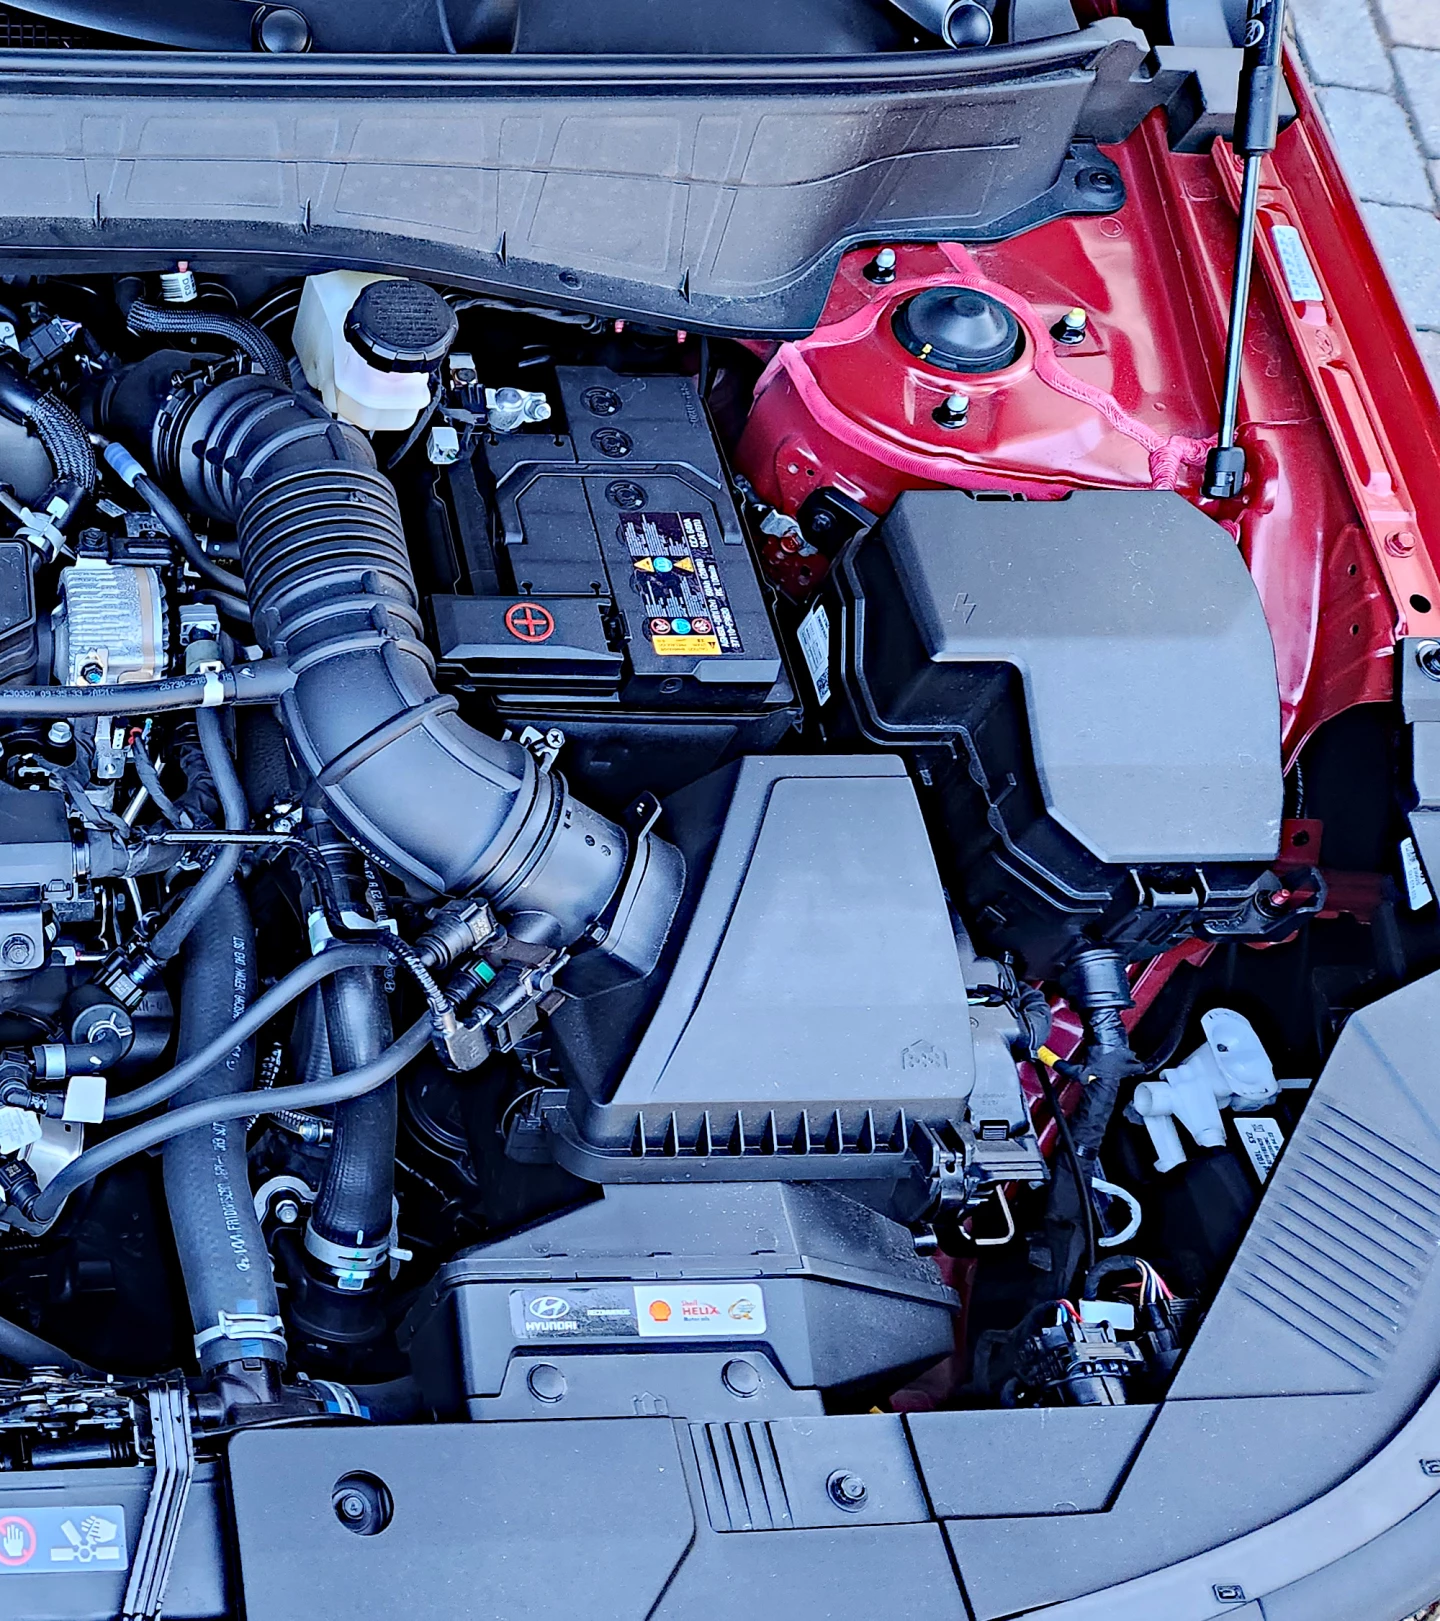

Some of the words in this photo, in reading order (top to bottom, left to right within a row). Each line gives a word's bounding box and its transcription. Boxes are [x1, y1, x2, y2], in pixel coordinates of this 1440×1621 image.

[182, 278, 192, 297] D03
[689, 534, 699, 548] CCA
[682, 1306, 720, 1316] HELIX
[526, 1321, 578, 1332] HYUNDAI
